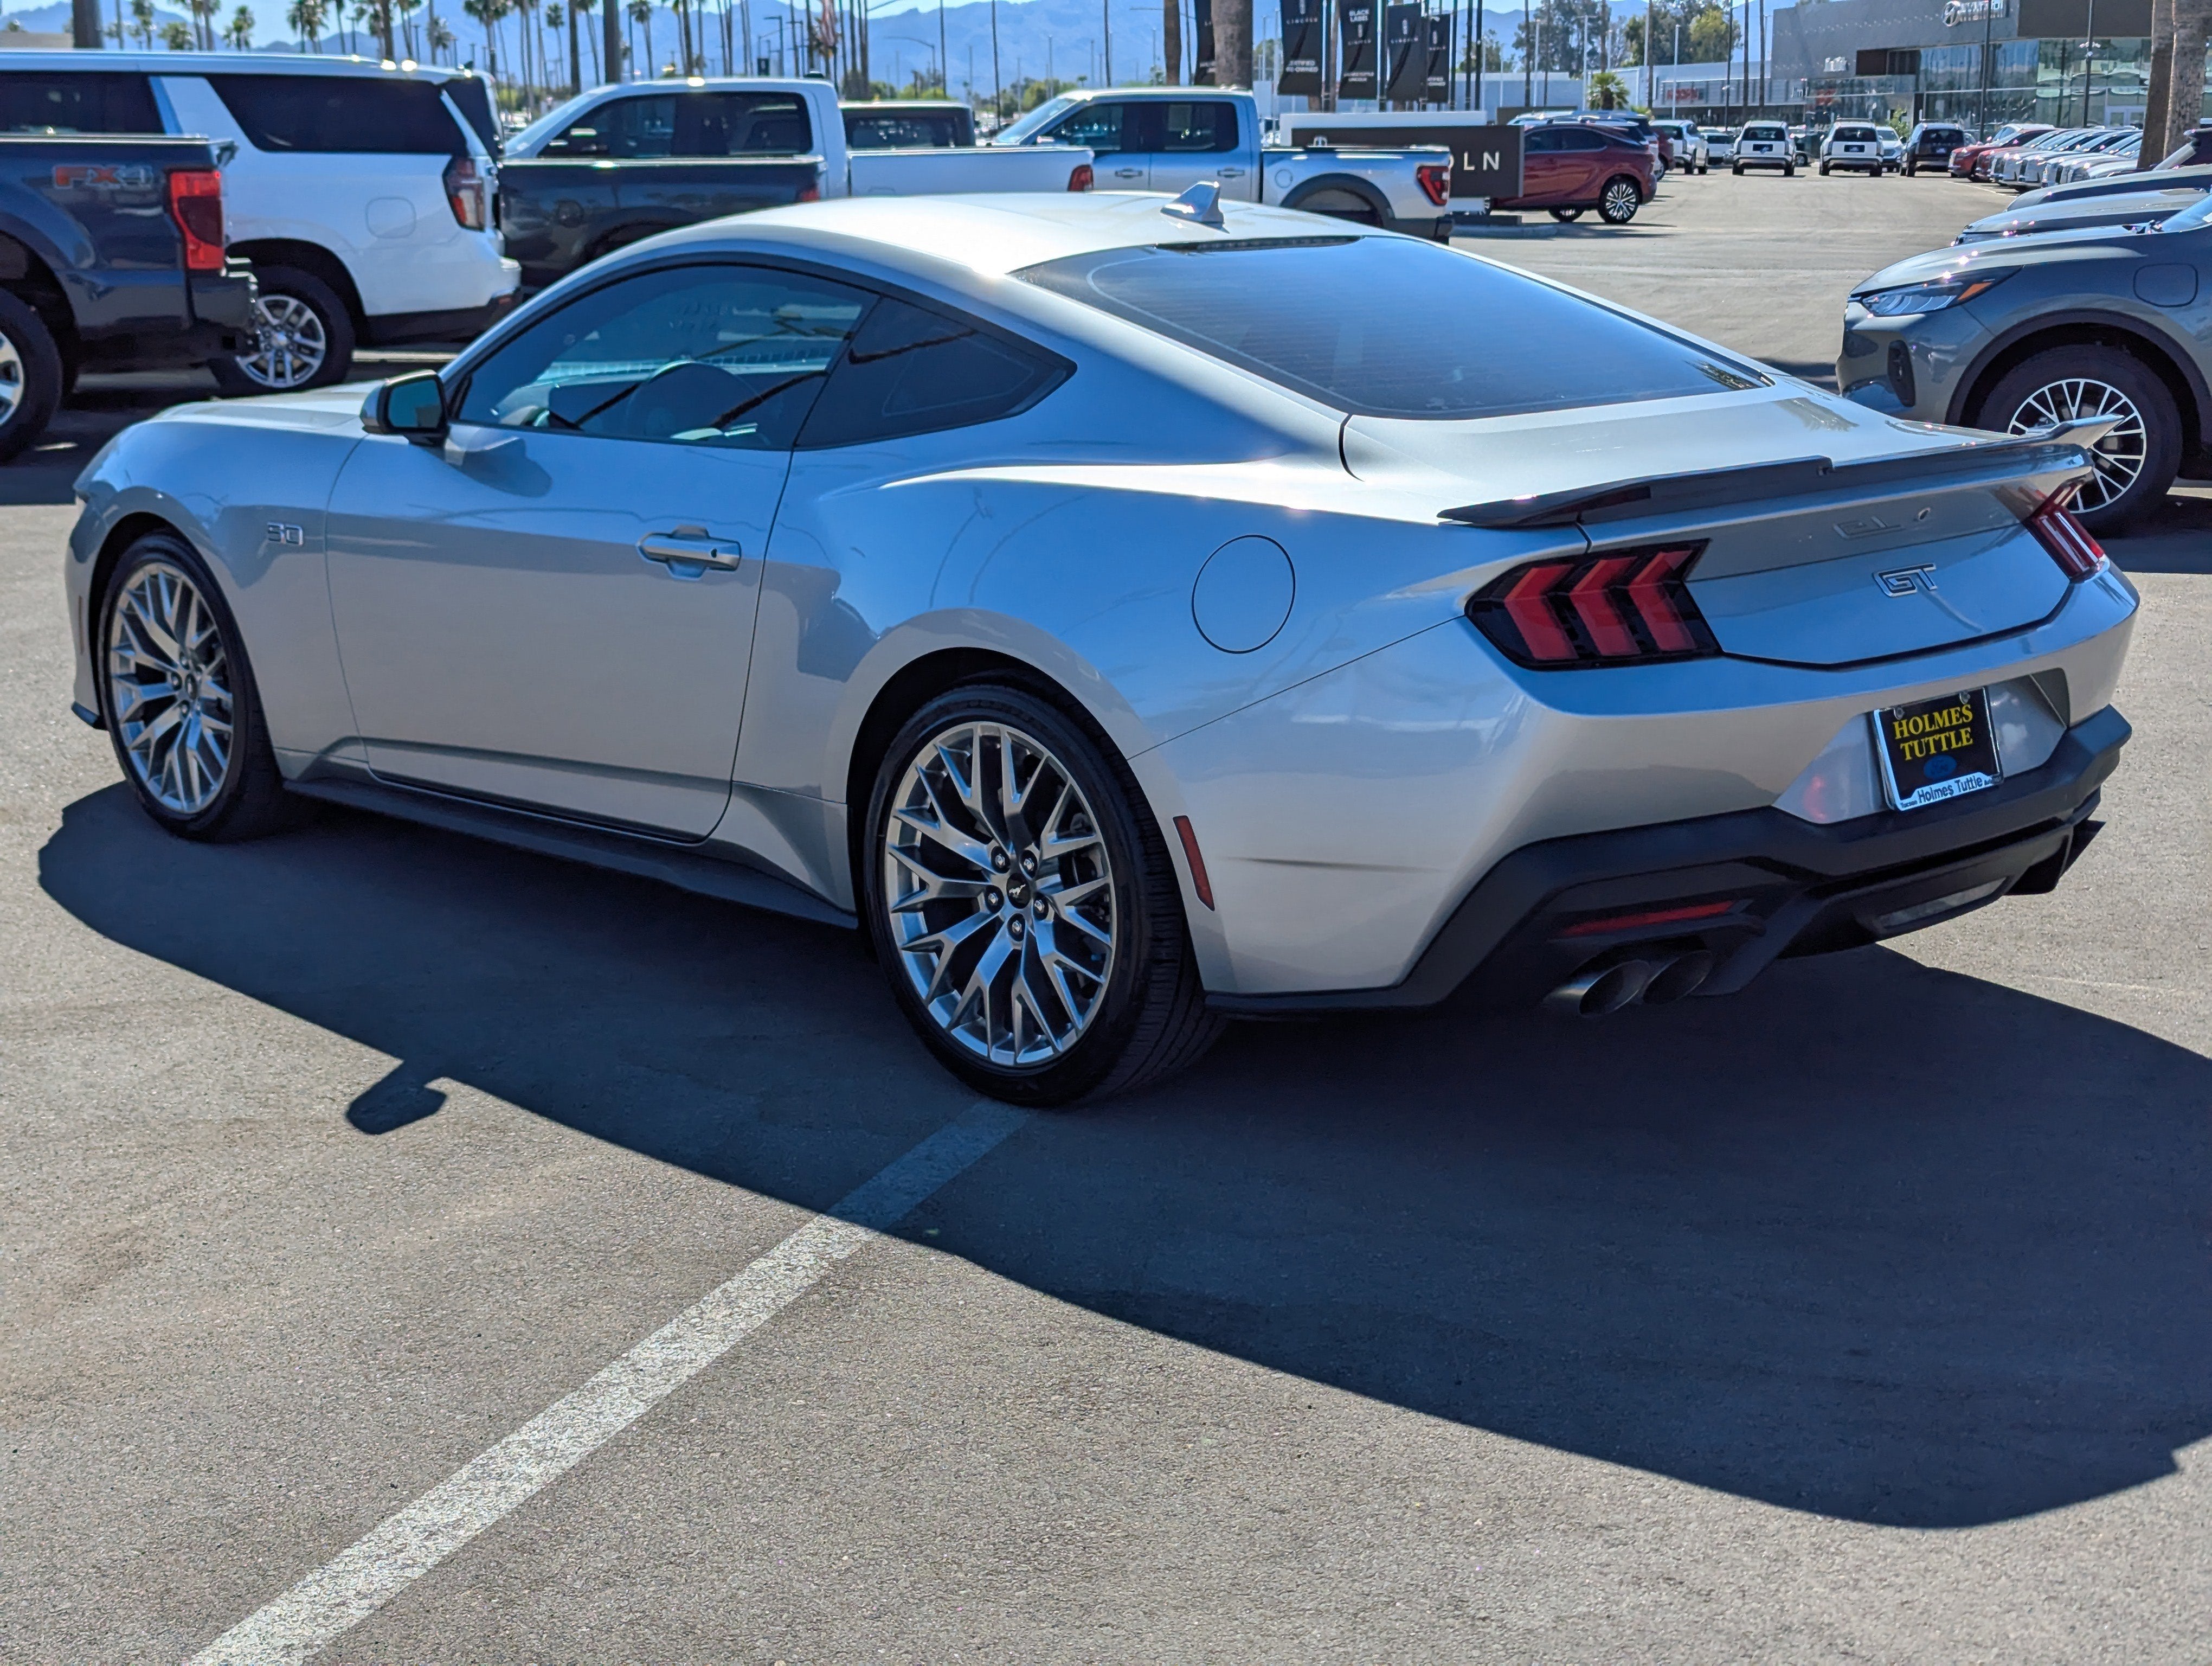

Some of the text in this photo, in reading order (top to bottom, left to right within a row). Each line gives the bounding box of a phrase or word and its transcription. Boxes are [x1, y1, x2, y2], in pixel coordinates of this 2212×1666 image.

[53, 164, 153, 190] FX4
[1872, 562, 1937, 598] GT
[1893, 703, 1973, 740] HOLMES
[1900, 727, 1973, 761] TUTTLE
[1917, 785, 1954, 804] Holmes
[1954, 775, 1983, 793] Tuttle
